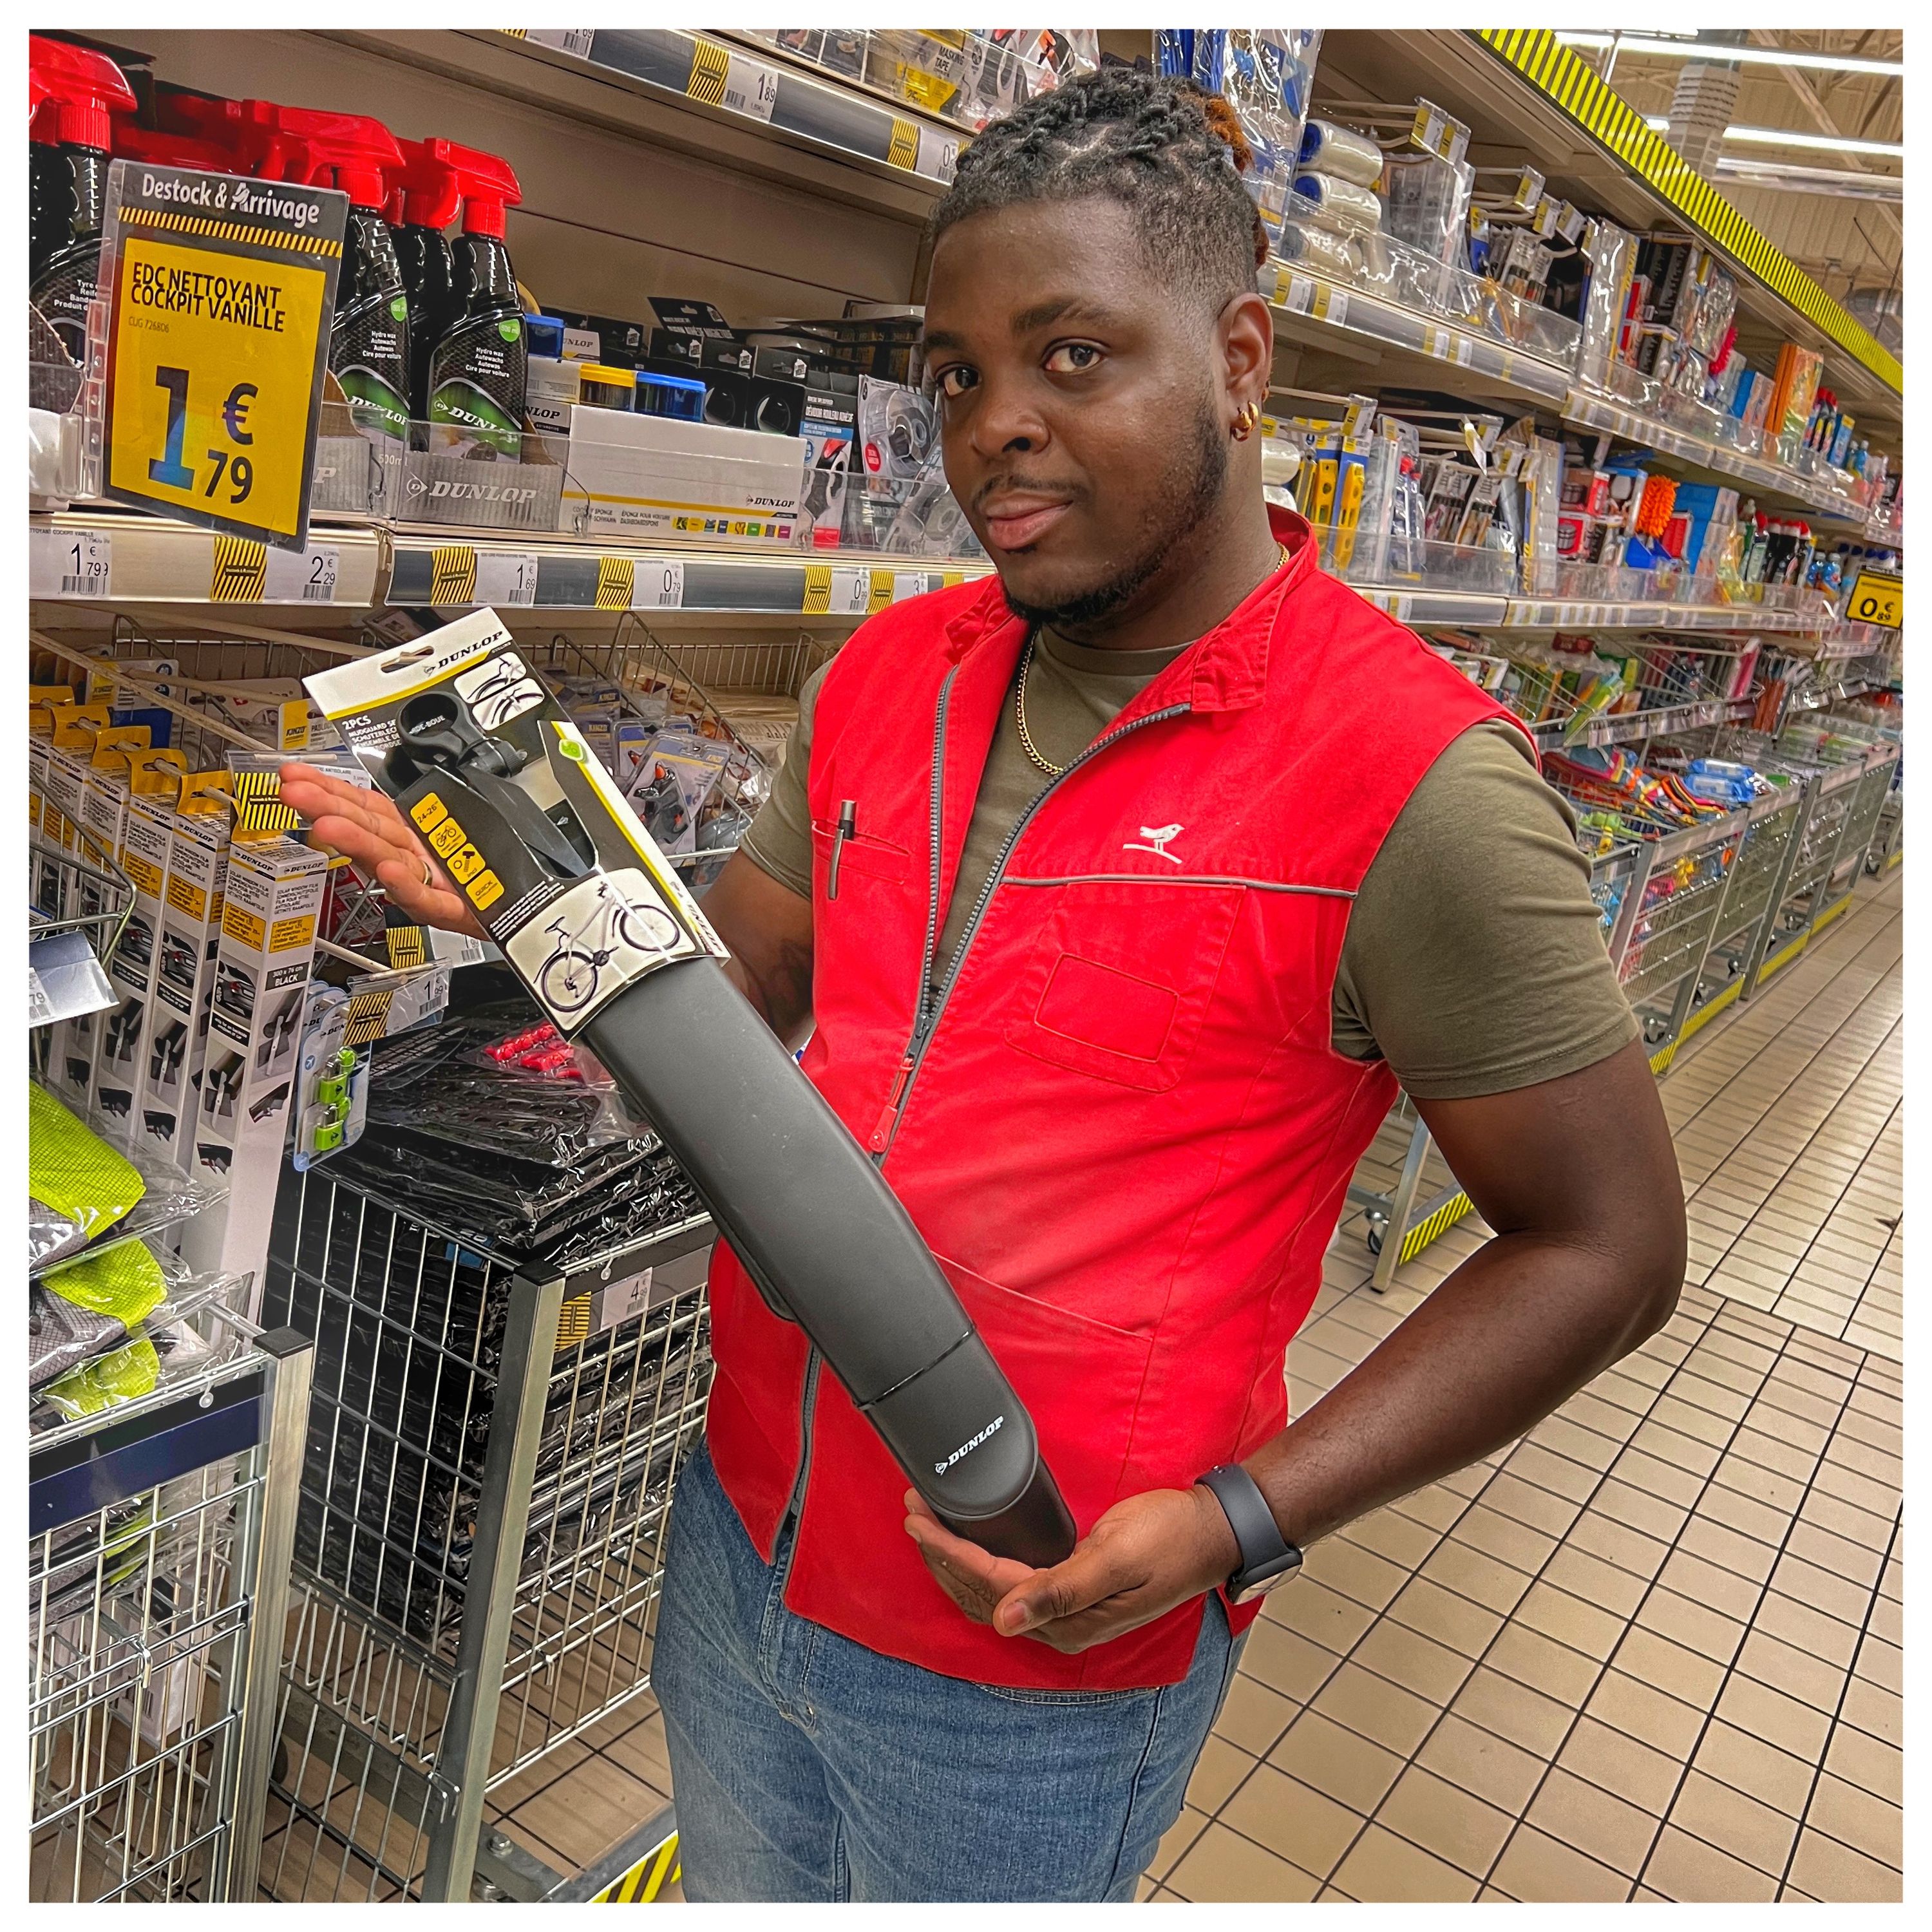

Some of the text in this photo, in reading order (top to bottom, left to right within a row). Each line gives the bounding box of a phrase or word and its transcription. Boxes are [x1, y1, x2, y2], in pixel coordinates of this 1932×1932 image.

[938, 46, 965, 65] MASKING
[935, 57, 949, 71] TAPE
[758, 73, 765, 100] 1
[764, 86, 775, 102] 89
[943, 144, 951, 167] 0
[142, 173, 320, 229] Destock & Arrivage
[77, 279, 94, 289] Tyre
[133, 261, 282, 309] EDC NETTOYANT
[54, 299, 82, 310] Produit
[131, 283, 286, 332] COCKPIT VANILLE
[129, 316, 144, 328] CUG
[372, 330, 386, 339] Hydro
[374, 344, 394, 352] Autowas
[563, 338, 593, 348] UNLOP
[475, 354, 504, 364] Autowachs
[477, 361, 500, 370] Autowas
[465, 364, 477, 372] Cire
[491, 369, 510, 378] voiture
[525, 406, 560, 419] NLOP
[149, 365, 259, 491] 1 €
[204, 449, 253, 504] 79
[429, 481, 537, 504] DUNLOP
[753, 497, 795, 507] DUNLOP
[71, 543, 97, 575] 1 €
[87, 562, 101, 576] 79
[310, 556, 333, 584] 2 €
[517, 564, 523, 589] 1
[323, 573, 336, 585] 29
[526, 579, 535, 589] 69
[664, 569, 672, 592] 0
[673, 582, 681, 592] 79
[854, 580, 861, 600] 0
[1859, 598, 1895, 617] 0 €
[438, 631, 502, 668] DUNLOP
[342, 715, 372, 730] 2PCS
[348, 722, 386, 737] MUDGUARD
[589, 724, 607, 732] KINZO
[140, 804, 171, 822] DUNLOP
[183, 826, 214, 842] DUNLOP
[240, 853, 274, 871] DUNLOP
[290, 862, 323, 873] DUNLOP
[229, 880, 237, 888] FILM
[230, 869, 242, 879] SOLAR
[242, 874, 258, 886] WINDOW
[475, 880, 493, 896] QUICK
[275, 901, 301, 909] ANTISOLAIRE
[292, 902, 314, 911] RAAMFOLIE
[274, 974, 299, 986] BLACK
[424, 981, 431, 1000] 1
[435, 985, 443, 996] 99
[327, 1024, 345, 1036] DUN
[630, 1281, 639, 1300] 4
[947, 1415, 1003, 1467] DUNLOP
